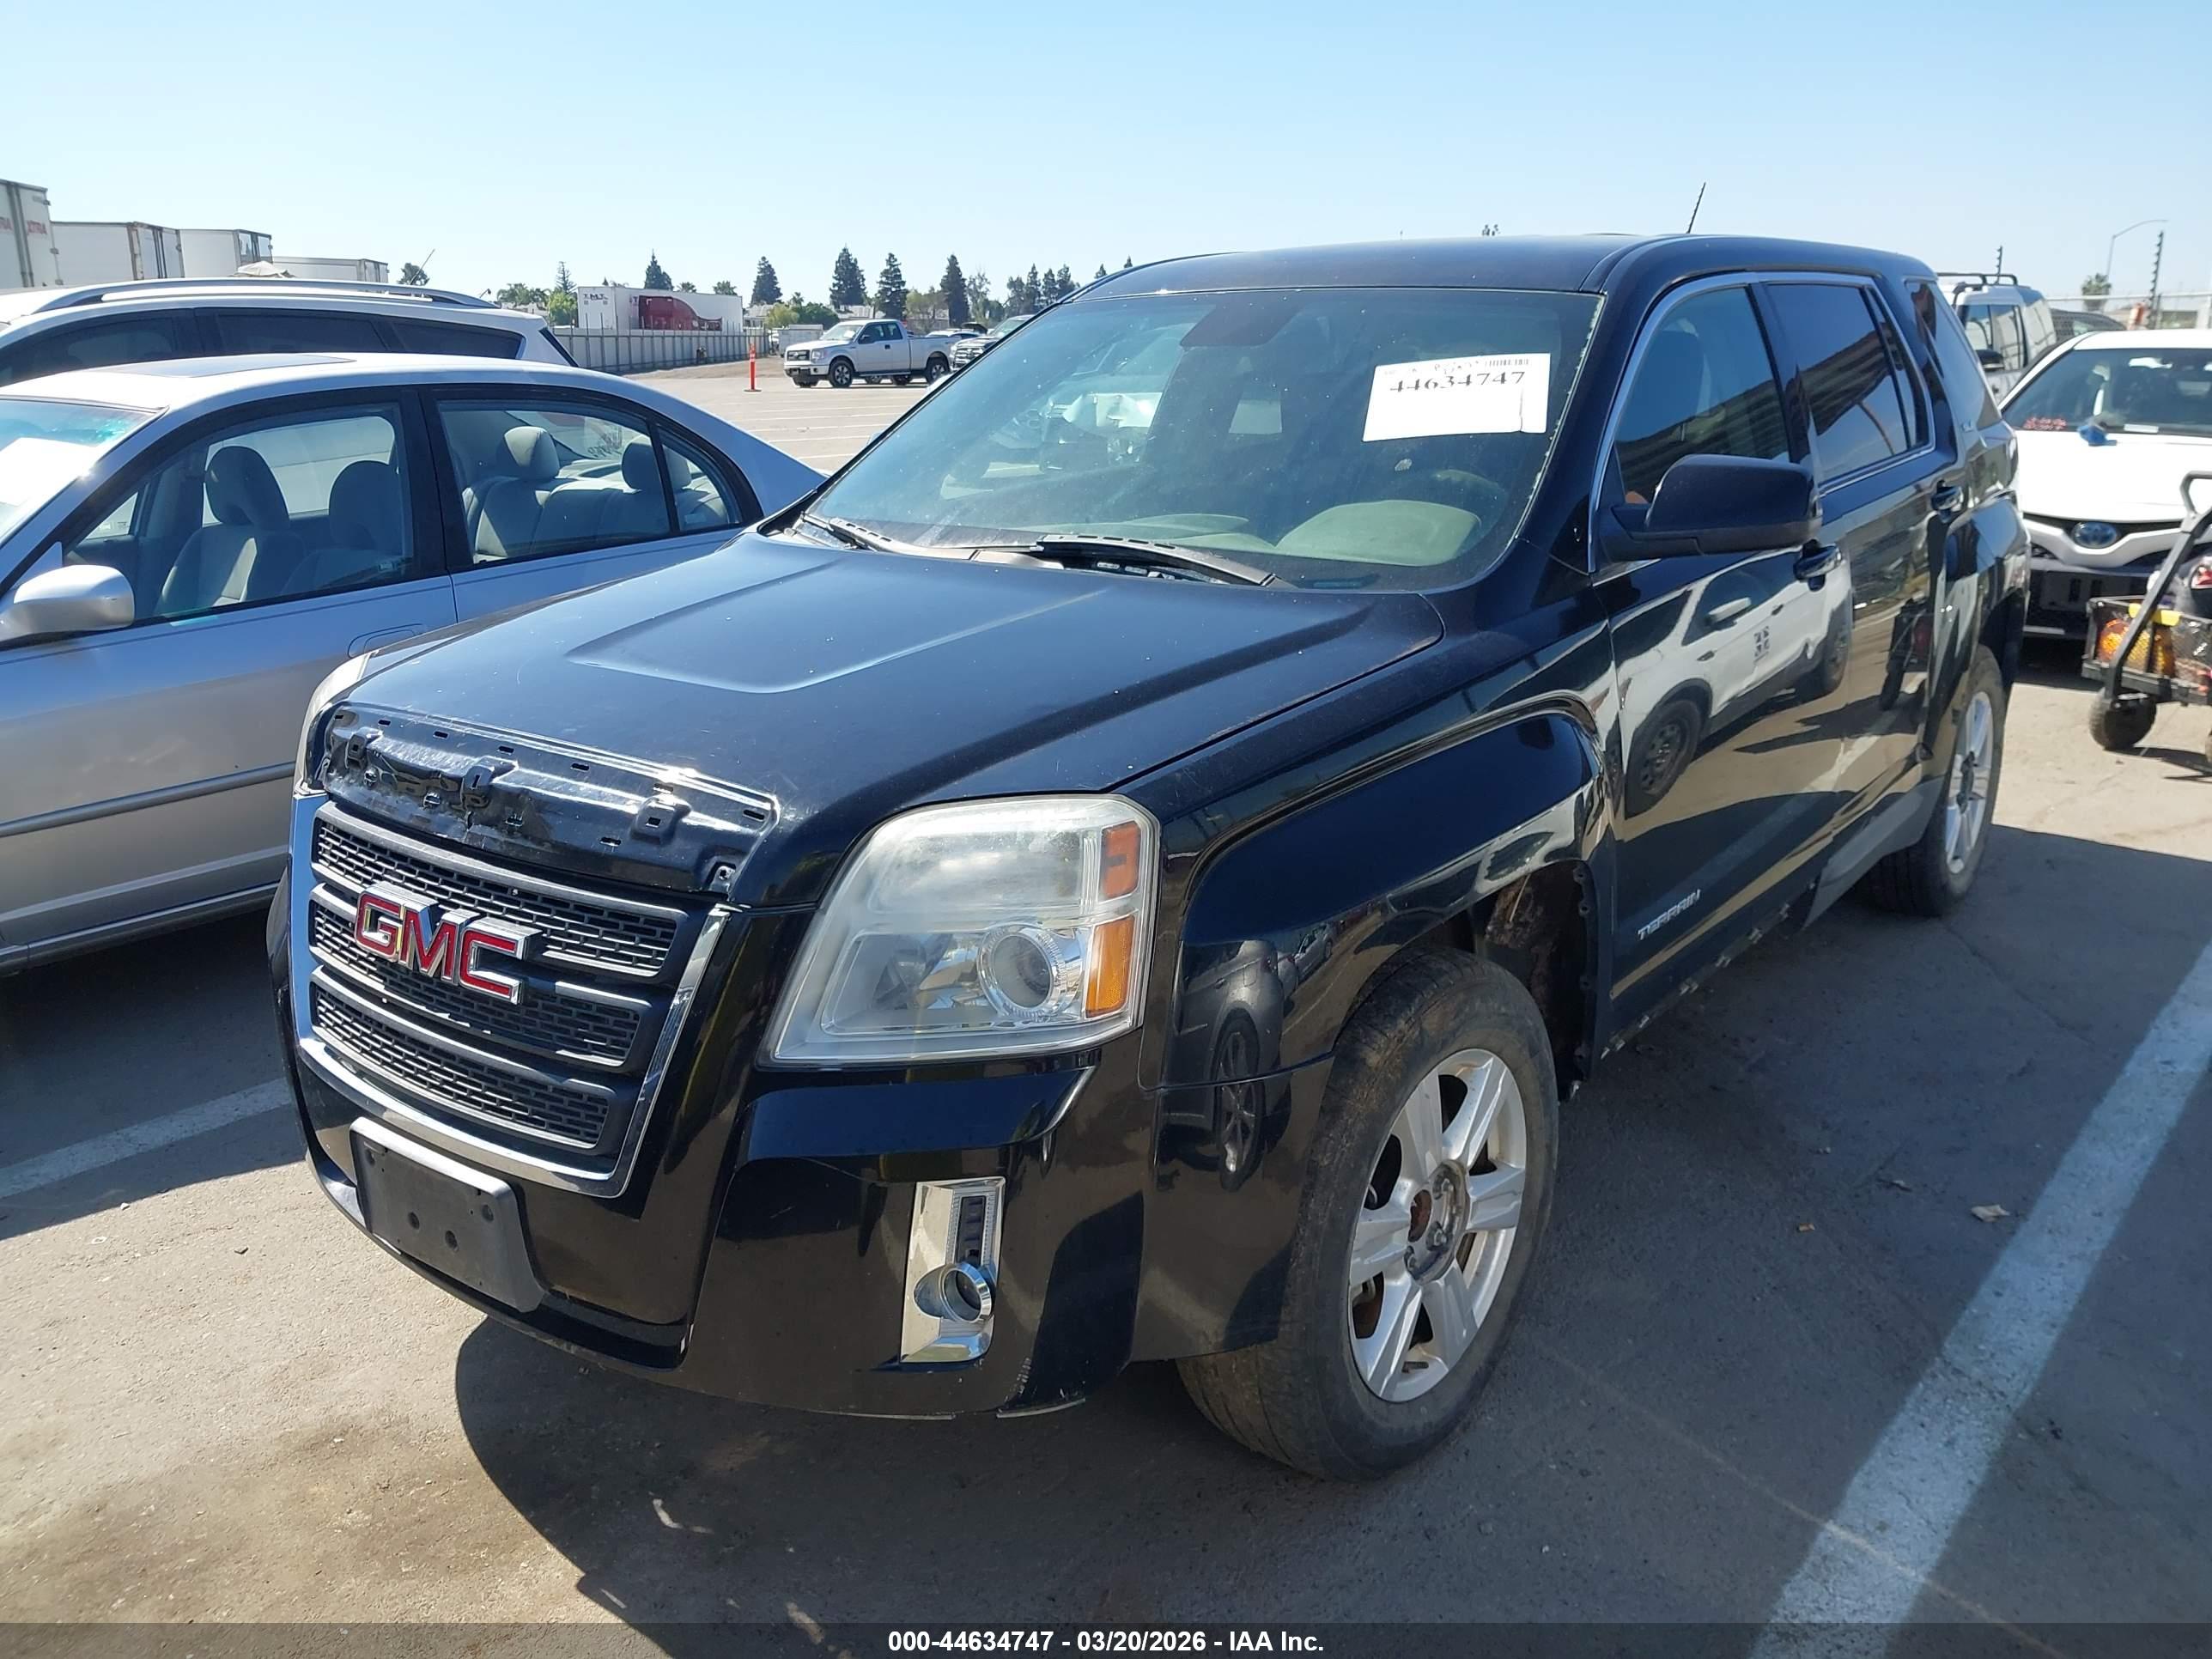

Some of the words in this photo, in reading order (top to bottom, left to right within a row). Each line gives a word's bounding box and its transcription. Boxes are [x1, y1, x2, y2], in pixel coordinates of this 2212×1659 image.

[1389, 371, 1526, 392] 44634747
[1638, 889, 1700, 940] TERRAIN
[354, 881, 542, 1005] GMC
